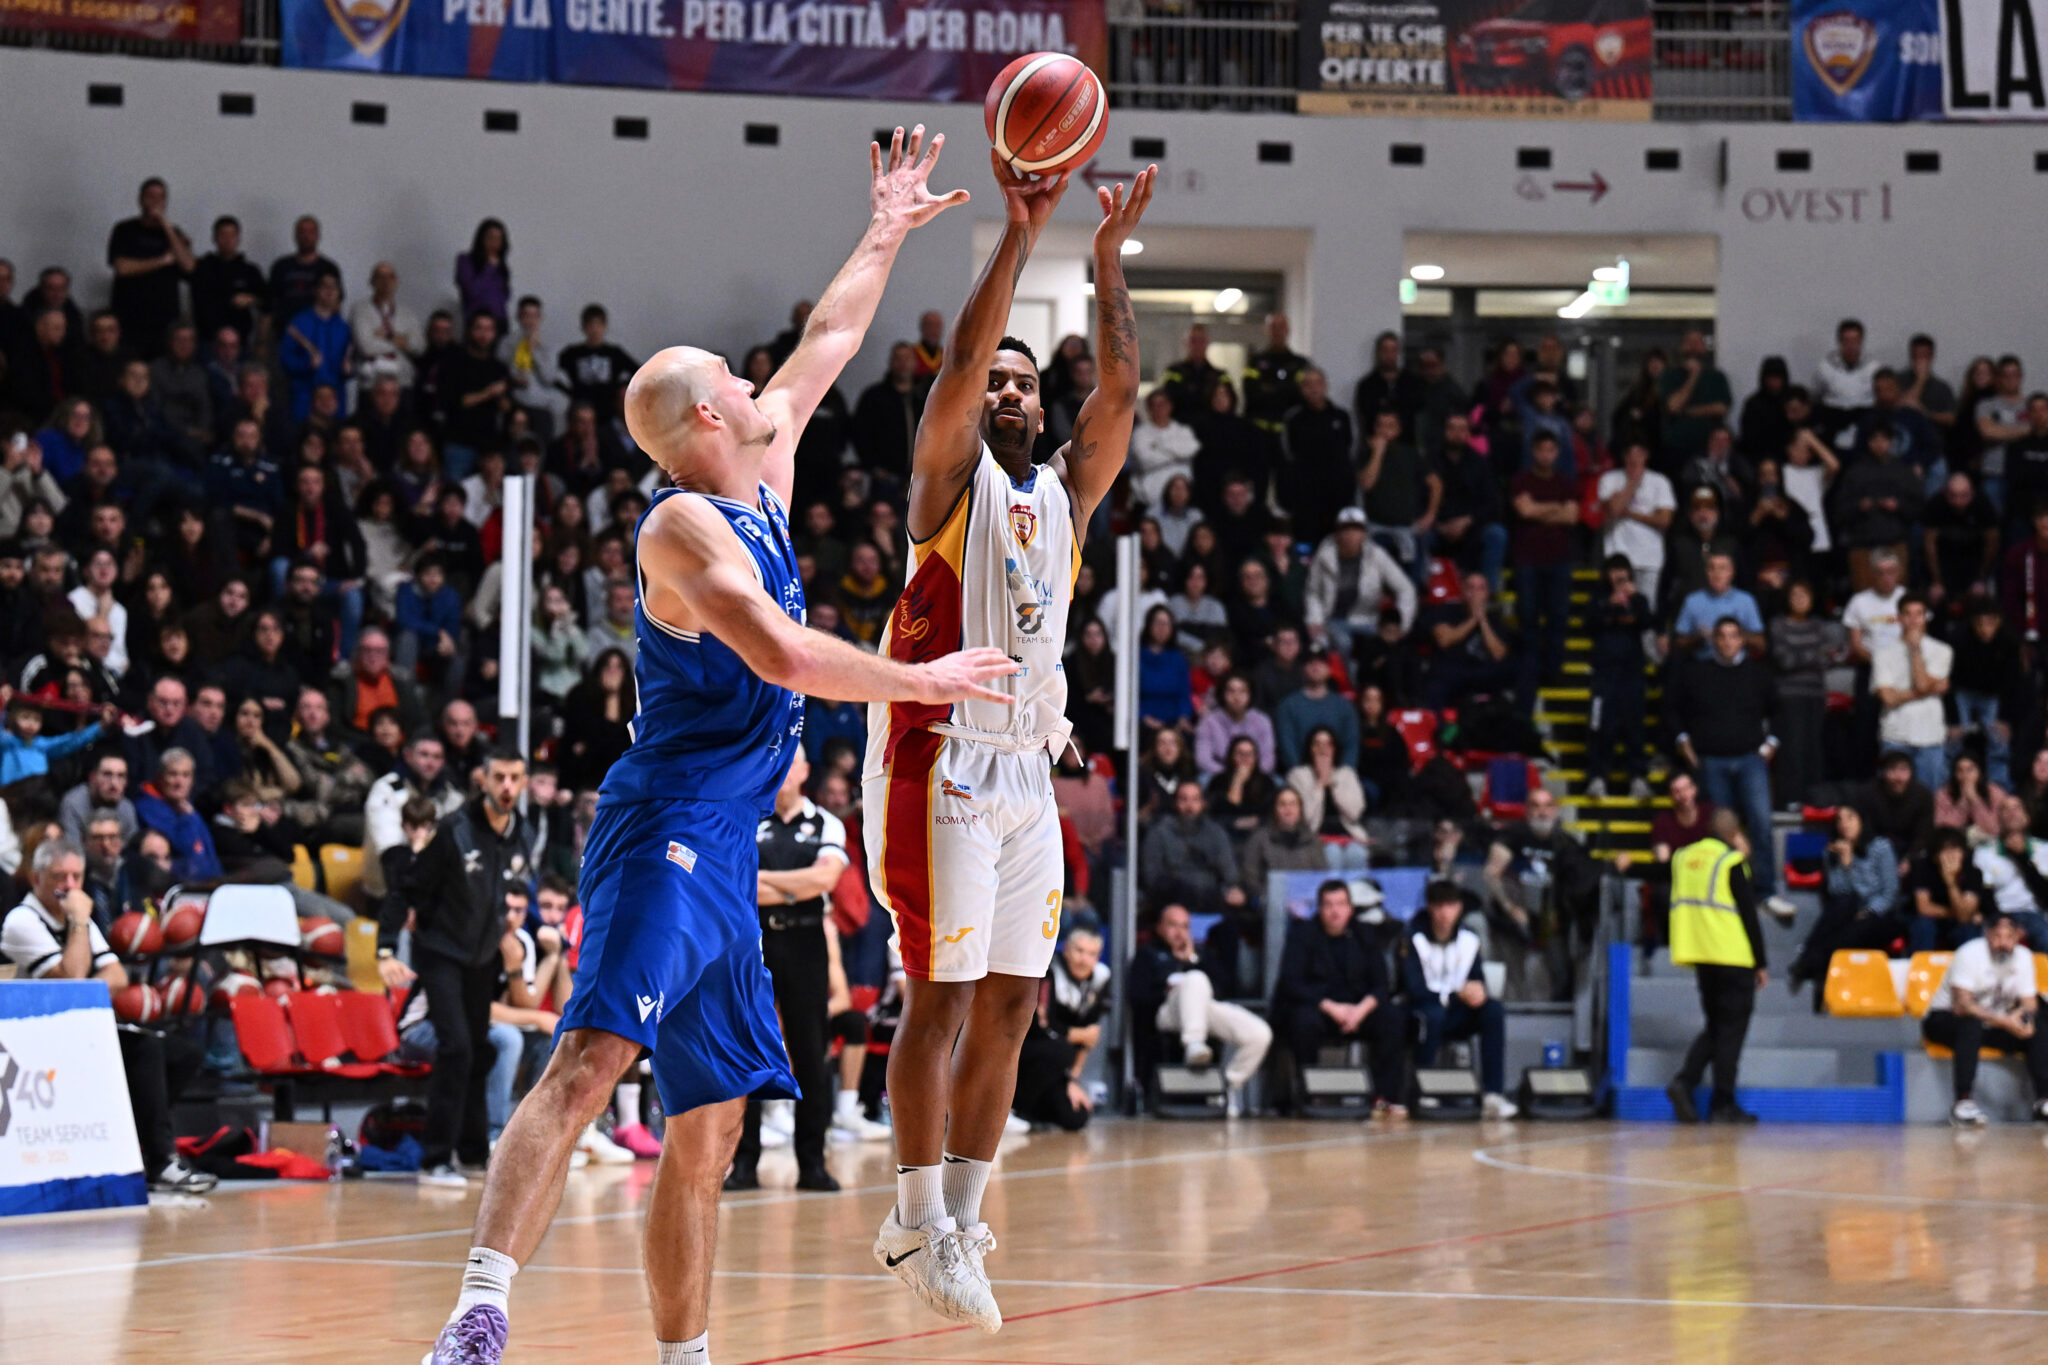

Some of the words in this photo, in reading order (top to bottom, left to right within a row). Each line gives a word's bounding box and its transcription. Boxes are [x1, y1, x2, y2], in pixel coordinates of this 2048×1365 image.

[443, 0, 505, 27] PER
[513, 0, 551, 28] LA
[565, 0, 675, 37] GENTE.
[682, 1, 745, 41] PER
[753, 3, 790, 44] LA
[905, 9, 969, 51] PER
[974, 13, 1078, 54] ROMA.
[1320, 22, 1363, 45] PER
[1369, 23, 1395, 45] TE
[1399, 23, 1446, 46] CHE
[1950, 0, 2047, 109] LA
[1319, 57, 1446, 86] OFFERTE
[1741, 186, 1870, 224] OVEST
[1016, 636, 1038, 644] TEAM
[935, 815, 967, 825] ROMA
[1042, 888, 1061, 939] 3
[16, 1125, 53, 1146] TEAM
[55, 1121, 110, 1144] SERVICE
